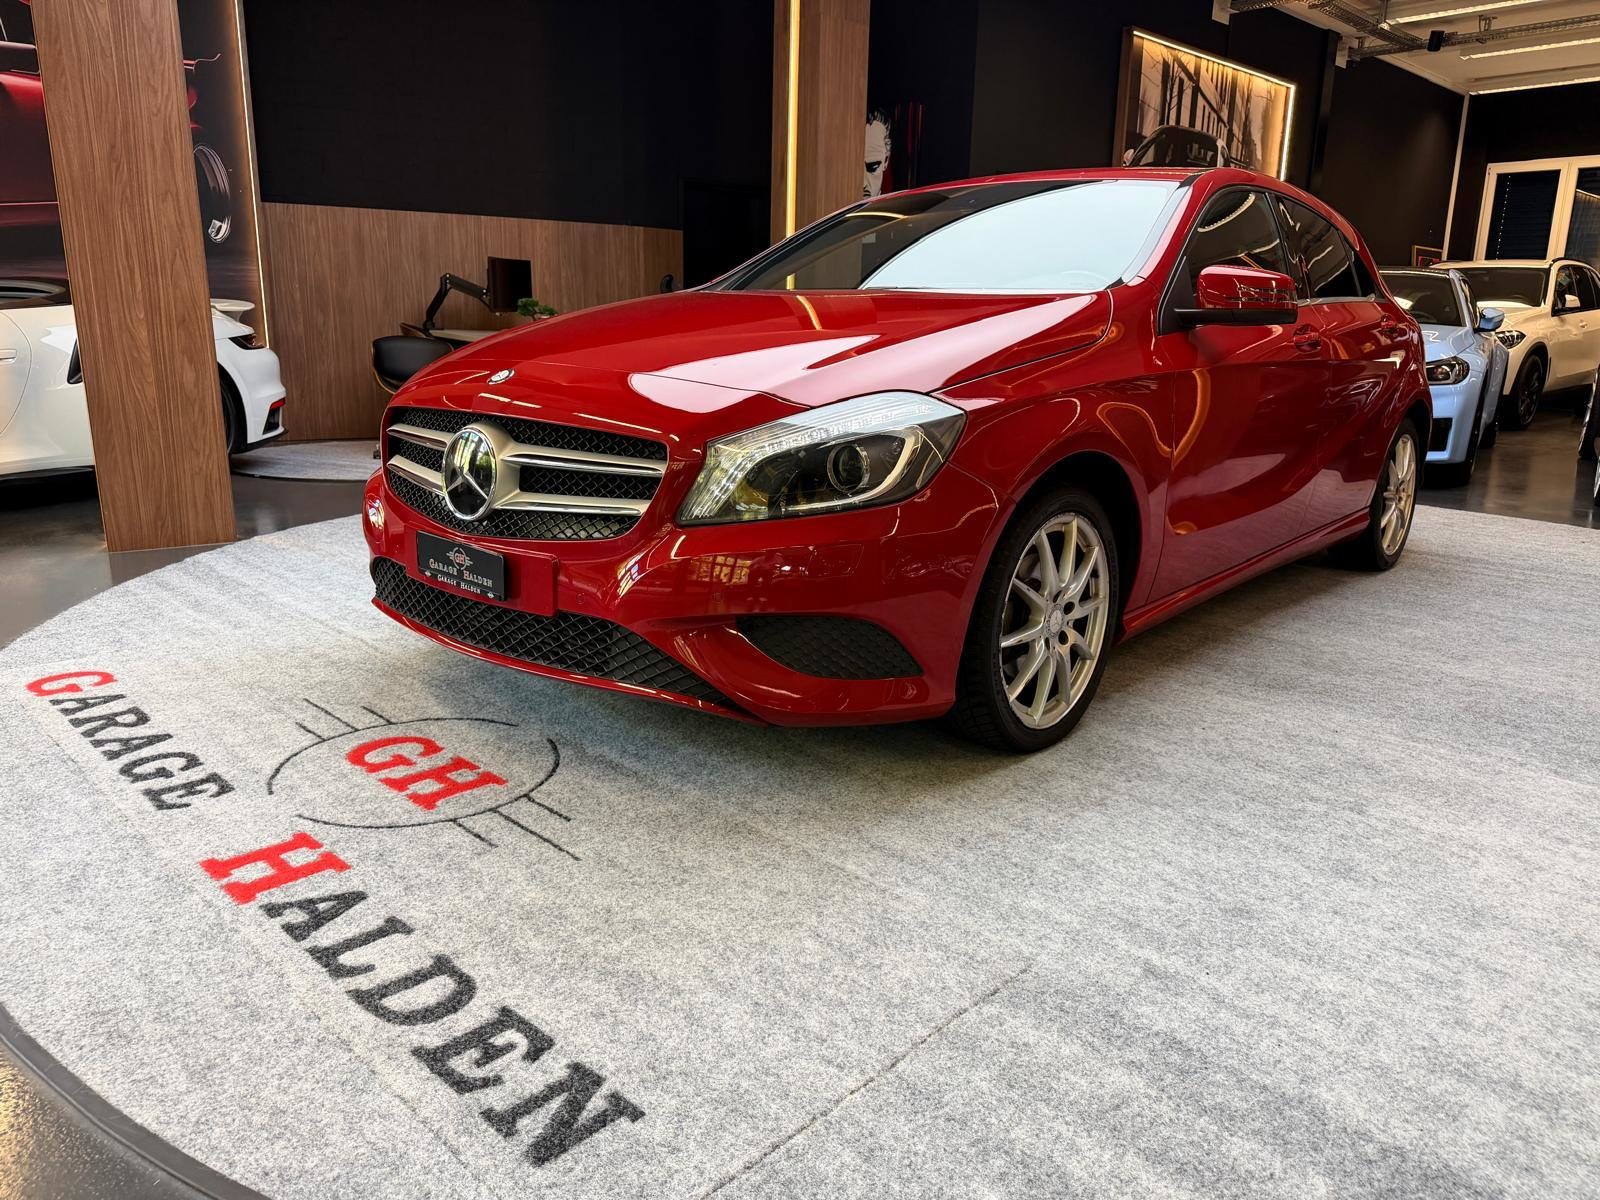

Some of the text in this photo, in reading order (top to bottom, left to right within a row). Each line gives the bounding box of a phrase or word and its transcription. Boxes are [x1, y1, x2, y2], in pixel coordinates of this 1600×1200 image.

[429, 558, 493, 587] GARAGE HALDEN
[346, 735, 508, 810] GH
[26, 670, 646, 1168] GARAGE HALDEN
